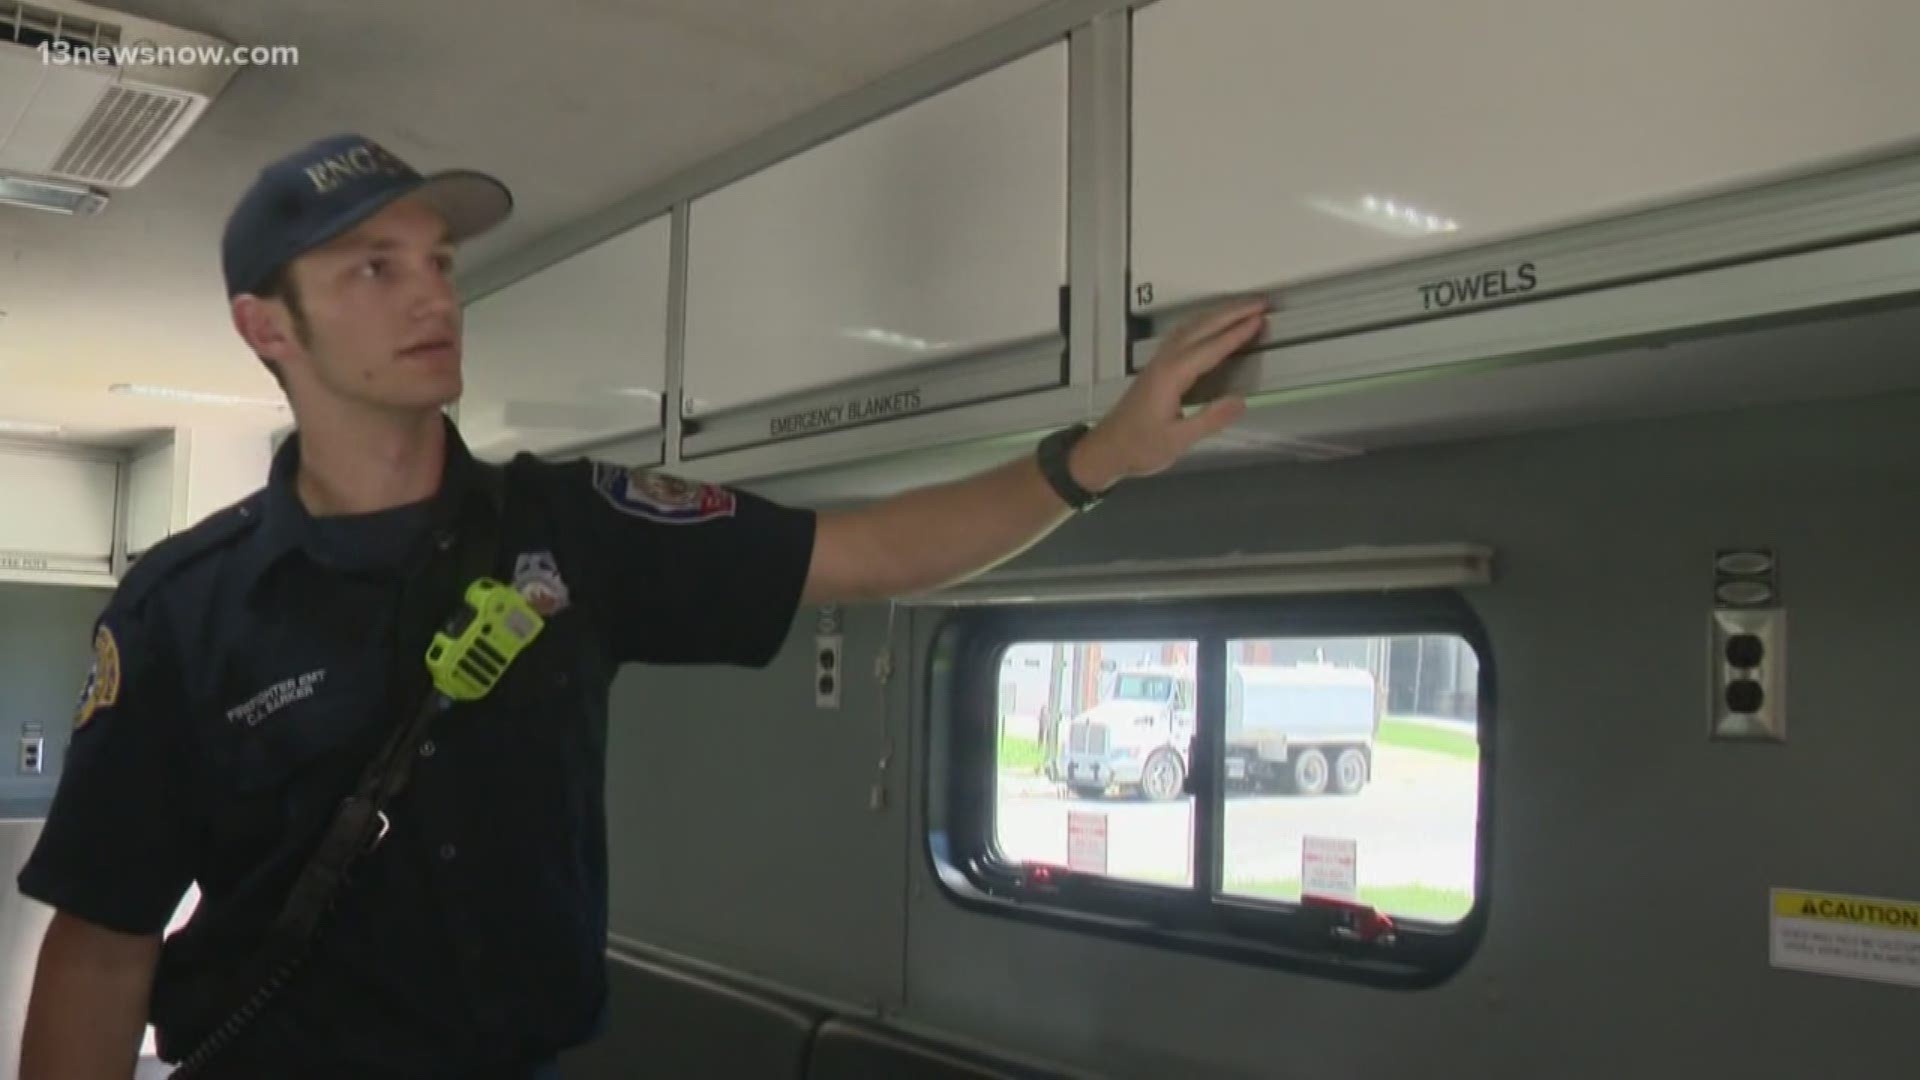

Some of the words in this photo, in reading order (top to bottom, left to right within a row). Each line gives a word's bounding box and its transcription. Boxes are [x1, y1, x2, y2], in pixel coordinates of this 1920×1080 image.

[1135, 282, 1153, 306] 13
[1418, 262, 1537, 310] TOWELS
[769, 406, 844, 437] EMERGENCY
[848, 388, 921, 420] BLANKETS
[298, 669, 326, 687] EMT
[1819, 899, 1919, 927] CAUTION
